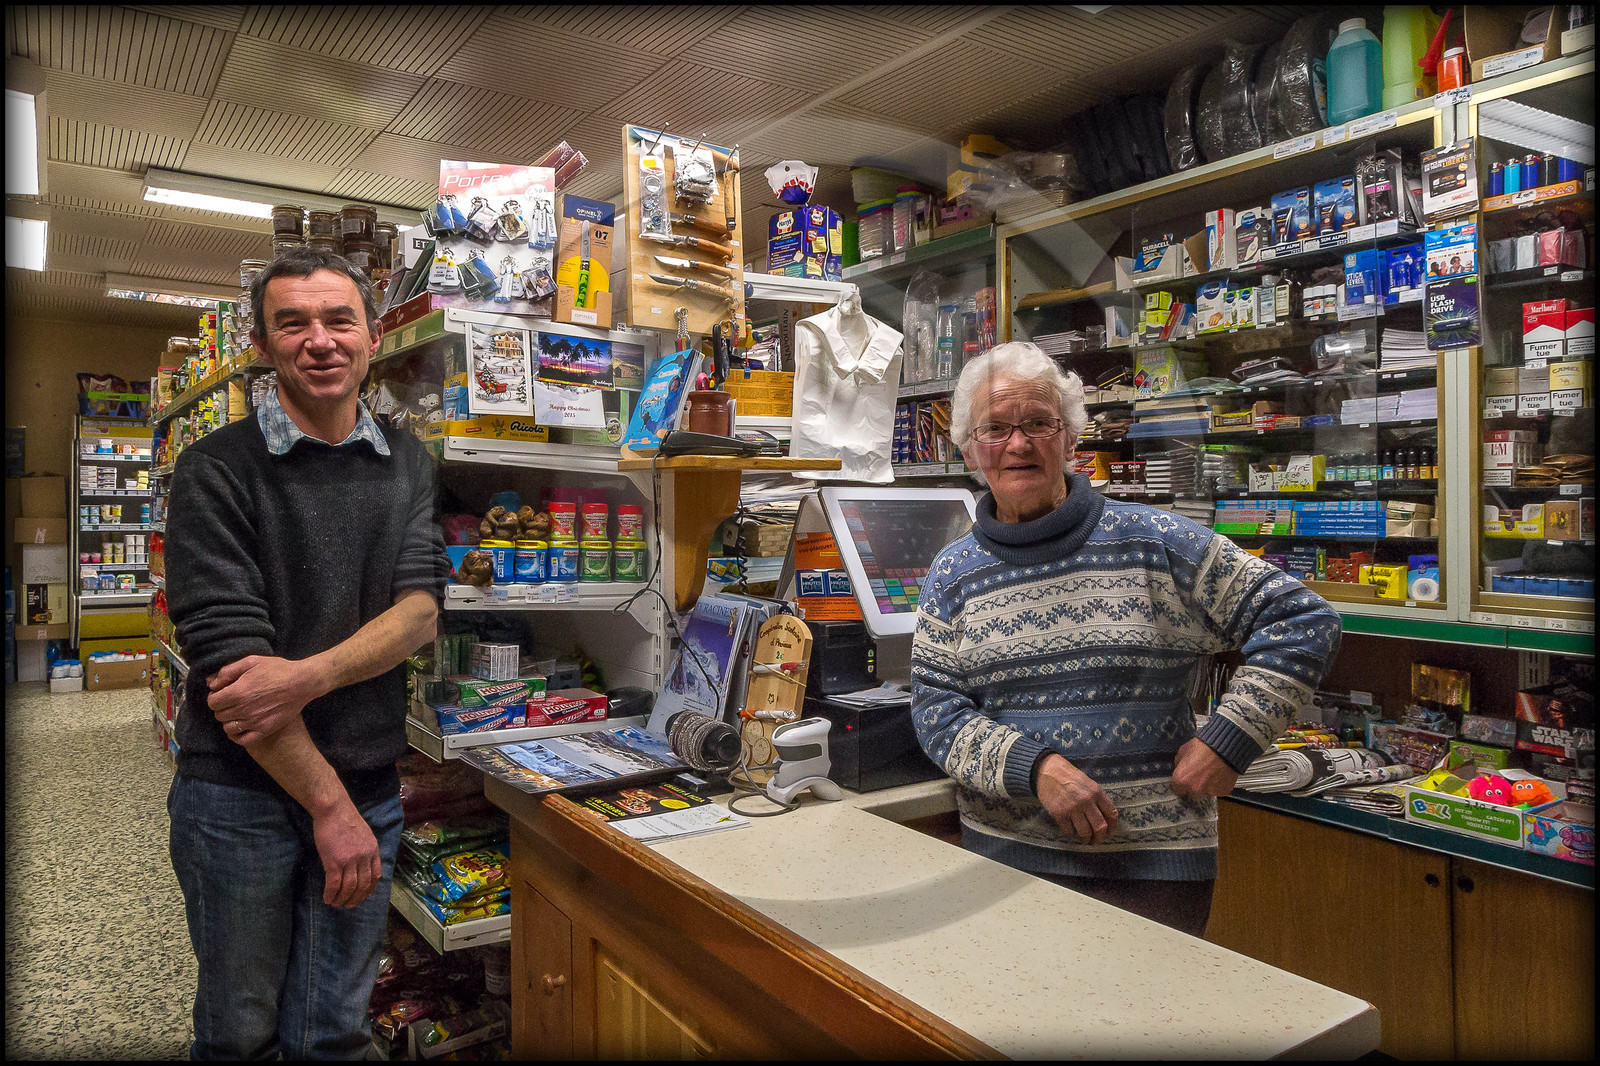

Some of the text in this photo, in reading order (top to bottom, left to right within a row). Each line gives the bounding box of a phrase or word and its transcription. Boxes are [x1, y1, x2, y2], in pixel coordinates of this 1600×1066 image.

[1442, 154, 1468, 168] LIBERTÉ
[576, 208, 597, 217] OPINEL
[1142, 241, 1170, 252] DURACELL
[1430, 294, 1446, 303] USB
[1430, 298, 1455, 309] FLASH
[1430, 304, 1454, 315] DRIVE
[1530, 303, 1557, 314] Marlboro
[1529, 343, 1558, 352] Fumer
[1552, 365, 1581, 375] CAMEL
[1521, 395, 1547, 403] Fumer
[1552, 391, 1581, 399] Fumer
[549, 402, 566, 412] Happy
[510, 420, 545, 434] Ricola
[480, 681, 527, 696] HOLLYWOOD
[545, 700, 587, 715] HOLLYWOOD
[458, 707, 505, 723] HOLLYWOOD
[1536, 726, 1573, 739] STAR
[1461, 814, 1482, 824] THROW
[1486, 815, 1505, 824] CATCH
